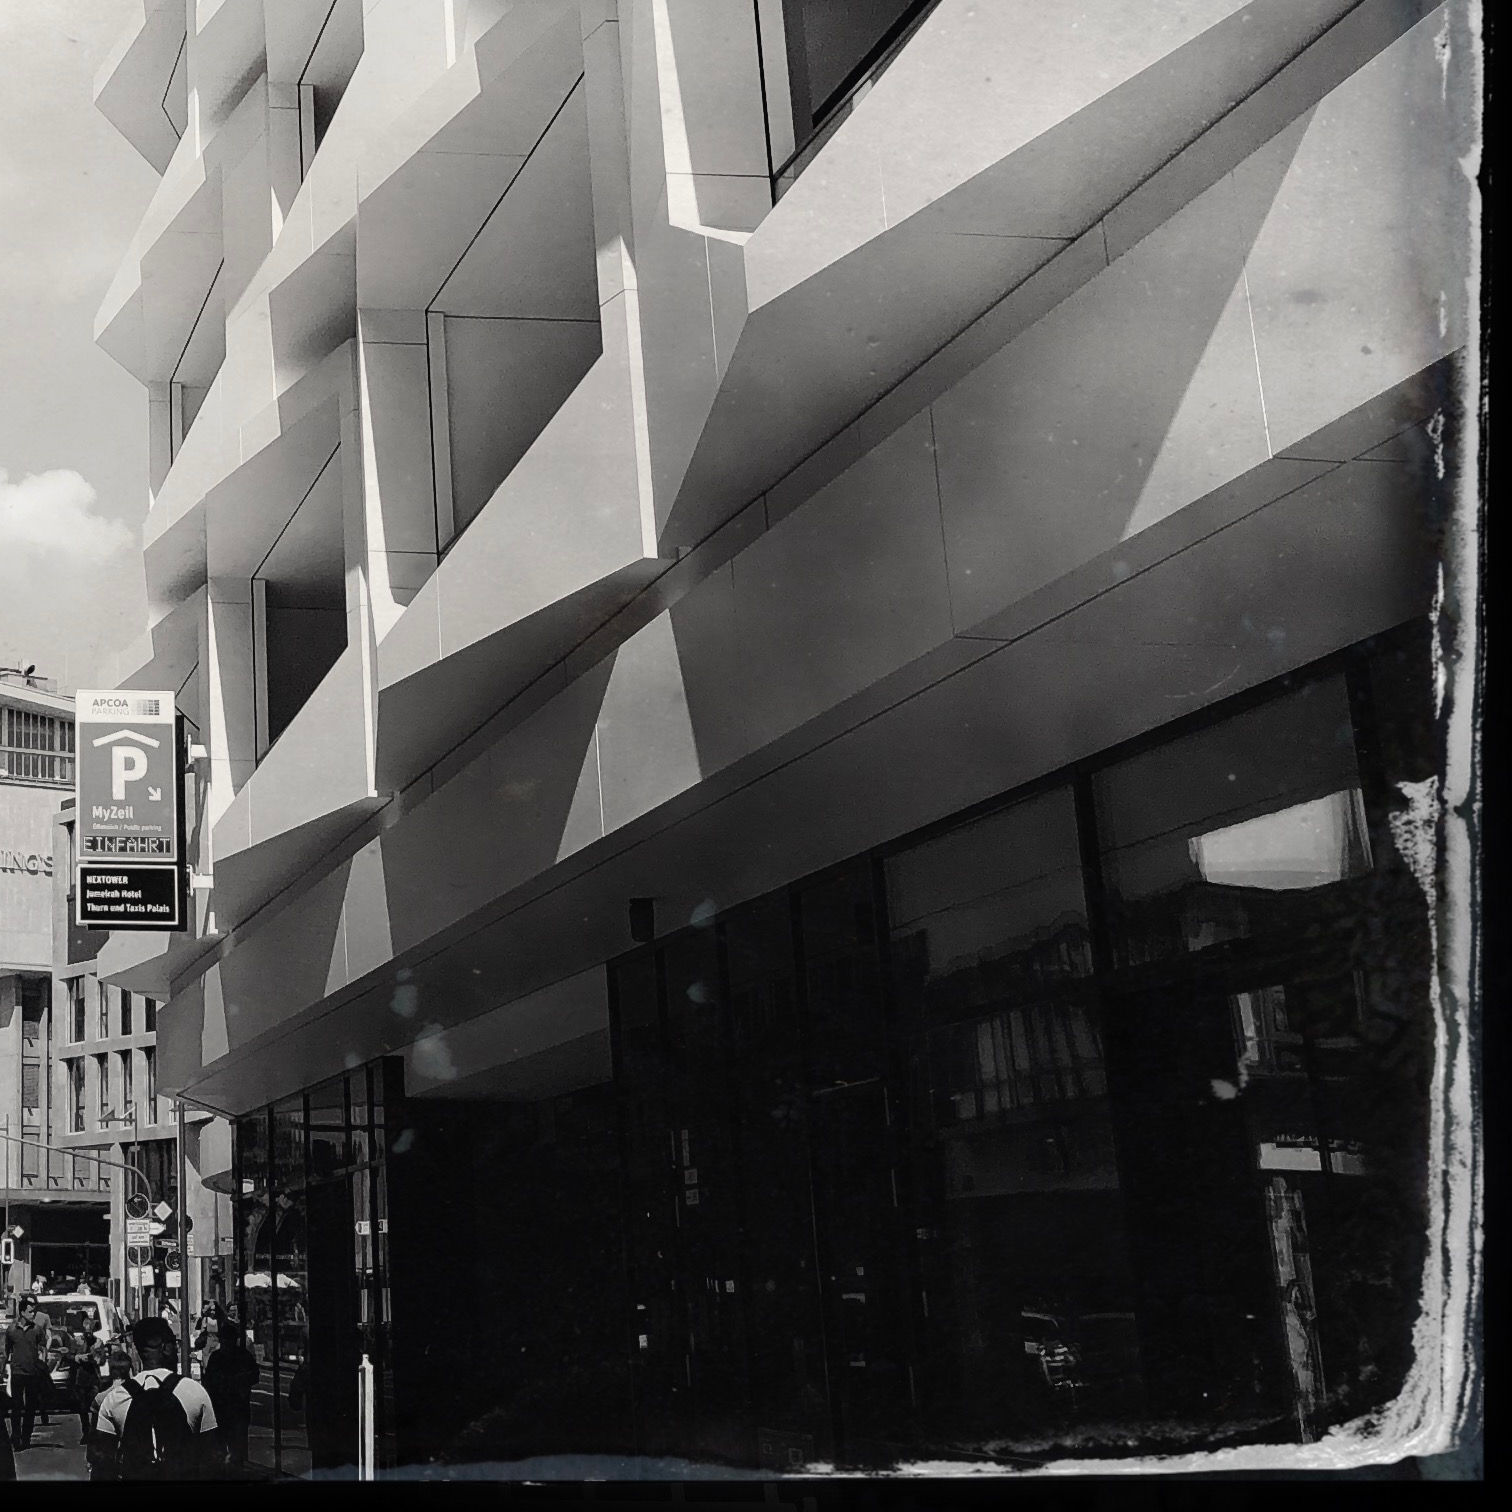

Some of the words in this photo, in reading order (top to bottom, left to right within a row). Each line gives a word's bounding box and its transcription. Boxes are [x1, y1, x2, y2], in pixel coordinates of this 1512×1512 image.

[92, 698, 129, 707] APCOA
[91, 707, 130, 716] PARKING
[112, 745, 148, 801] P
[92, 805, 134, 822] MyZeil
[83, 836, 171, 854] EINFAHRT
[86, 875, 129, 884] NEXTOWER
[121, 889, 142, 898] Hotel
[86, 903, 109, 912] Thurn
[109, 903, 125, 912] und
[126, 903, 146, 913] Taxis
[146, 904, 170, 913] Palais
